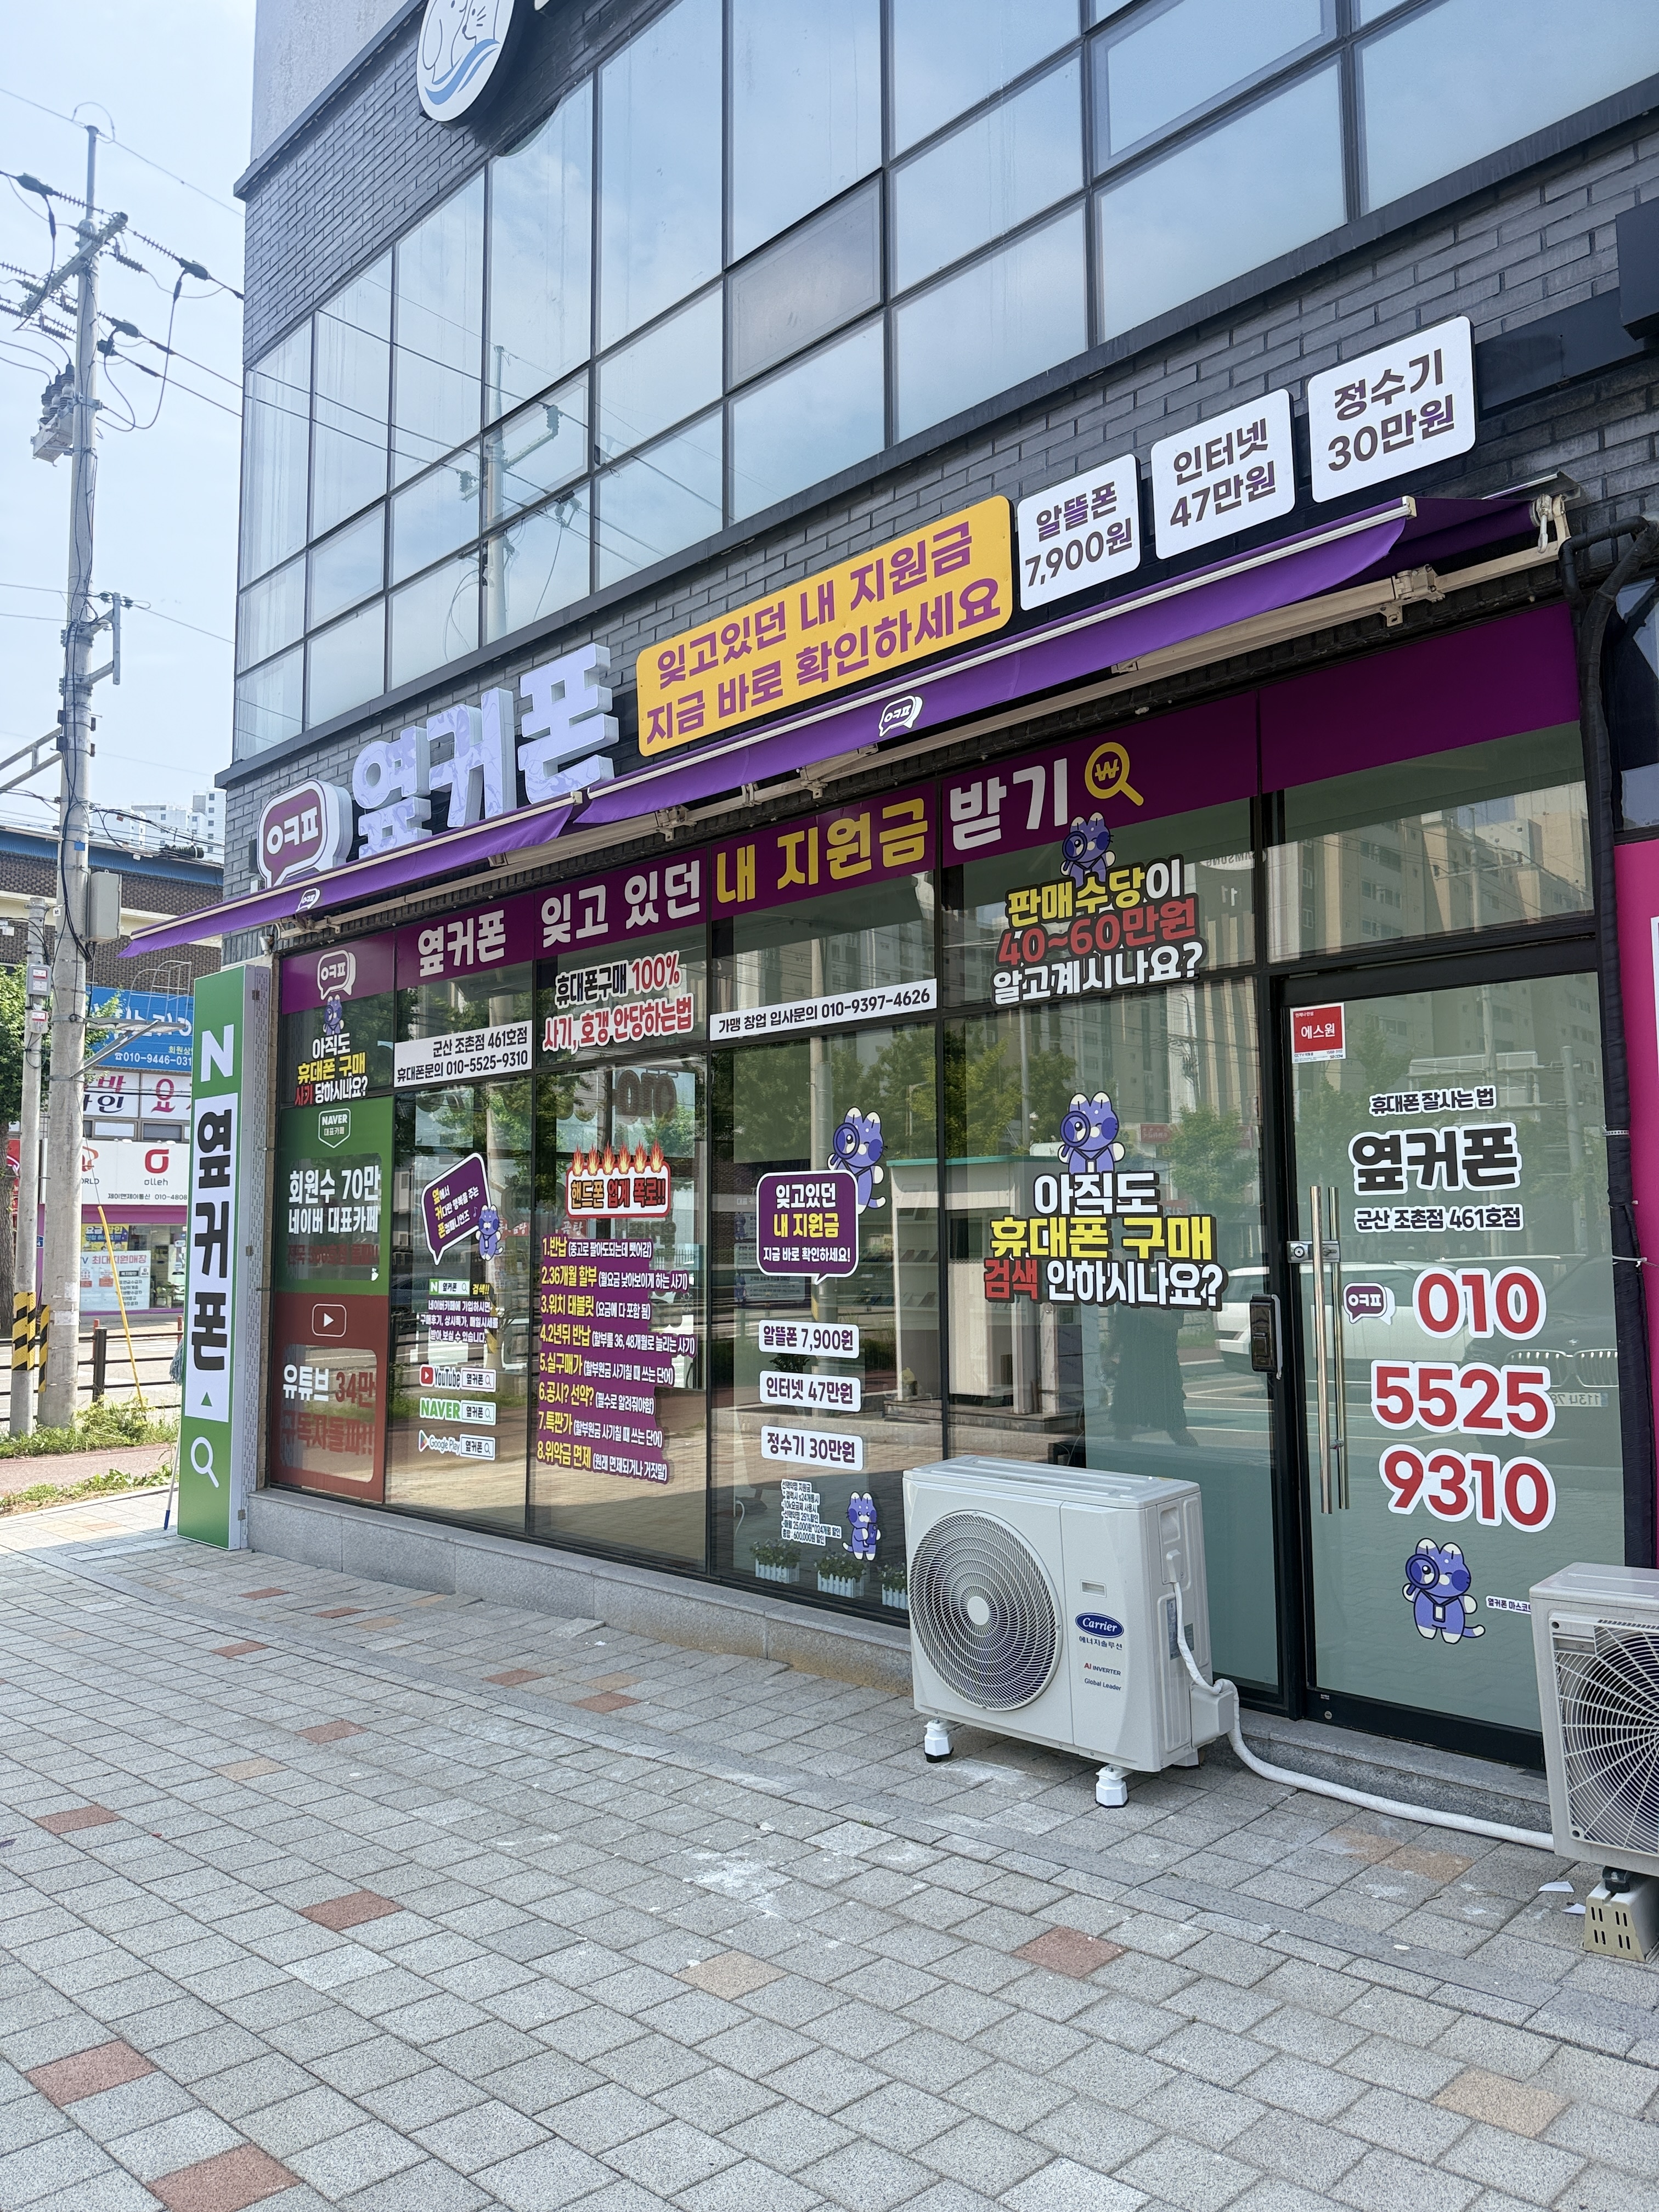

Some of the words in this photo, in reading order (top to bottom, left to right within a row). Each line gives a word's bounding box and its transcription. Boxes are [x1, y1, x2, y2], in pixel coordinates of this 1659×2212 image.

[1334, 348, 1443, 421] 정수기
[1328, 394, 1455, 472] 30만원
[1173, 417, 1268, 487] 인터넷
[1170, 460, 1276, 528] 47만원
[1036, 482, 1117, 542] 알뜰폰
[1025, 518, 1133, 589] 7,900원
[658, 601, 786, 690] 잊고있던
[800, 580, 834, 631] 내
[850, 521, 972, 611] 지원금
[646, 690, 706, 745] 지금
[718, 661, 783, 719] 바로
[796, 577, 1001, 686] 확인하세요
[352, 643, 619, 859] 옆커폰
[418, 909, 506, 978] 옆커폰
[541, 884, 608, 948] 잊고
[623, 860, 700, 930] 있던
[716, 845, 755, 904] 내
[777, 798, 928, 890] 지원금
[950, 758, 1068, 851] 받기
[1008, 859, 1180, 927] 판매수당이
[998, 897, 1195, 966] 40~60만원
[557, 963, 627, 1006] 휴대폰구매
[632, 952, 679, 992] 100%
[993, 942, 1203, 1006] 알고계시나요?
[545, 1015, 578, 1051] 사기,
[581, 1010, 609, 1043] 호갱
[614, 996, 691, 1039] 안당하는법
[719, 1016, 741, 1034] 가맹
[744, 1013, 766, 1030] 창업
[770, 1005, 818, 1027] 입사문의
[821, 988, 930, 1019] 010-9397-4626
[312, 1033, 351, 1059] 아직도
[433, 1039, 452, 1058] 군산
[455, 1034, 484, 1054] 조촌점
[487, 1026, 527, 1049] 461호점
[1301, 1023, 1335, 1039] 에스원
[123, 1052, 191, 1066] 010-9446-031
[201, 1024, 234, 1082] N
[297, 1060, 335, 1085] 휴대폰
[338, 1052, 366, 1077] 구매
[397, 1063, 443, 1083] 휴대폰문의
[446, 1050, 527, 1076] 010-5525-9310
[294, 1084, 313, 1105] 사기
[315, 1076, 368, 1104] 당하시나요?
[1372, 1093, 1419, 1115] 휴대폰
[1422, 1091, 1473, 1110] 잘사는
[1477, 1087, 1493, 1107] 법
[321, 1114, 348, 1125] NAVER
[1352, 1127, 1517, 1191] 옆커폰
[289, 1170, 335, 1204] 회원수
[341, 1165, 381, 1201] 70만
[432, 1184, 450, 1205] 옆에서
[571, 1178, 603, 1209] 핸드폰
[607, 1178, 630, 1208] 업계
[634, 1178, 665, 1206] 폭로!!
[776, 1182, 836, 1209] 잊고있던
[1034, 1173, 1158, 1215] 아직도
[288, 1206, 324, 1235] 네이버
[328, 1204, 379, 1233] 대표카페
[435, 1201, 453, 1221] 커다란
[452, 1192, 469, 1210] 행복을
[467, 1186, 479, 1200] 주는
[1357, 1210, 1389, 1230] 군산
[1394, 1209, 1443, 1229] 조촌점
[1449, 1207, 1520, 1228] 461호점
[191, 1108, 232, 1372] 옆커폰
[774, 1212, 788, 1239] 내
[792, 1212, 839, 1239] 지원금
[991, 1217, 1108, 1258] 휴대폰
[1122, 1217, 1211, 1260] 구매
[543, 1238, 567, 1257] 1.반납
[568, 1242, 589, 1257] (중고로
[590, 1242, 628, 1257] 팔아도되는데
[763, 1247, 780, 1262] 지금
[782, 1247, 800, 1262] 바로
[802, 1247, 851, 1263] 확인하세요!
[431, 1282, 438, 1292] N
[472, 1284, 490, 1295] 검색!!
[541, 1265, 577, 1286] 2.36개월
[579, 1265, 597, 1288] 할부
[599, 1271, 620, 1288] (월요금
[622, 1272, 654, 1289] 낮아보이게
[656, 1272, 669, 1289] 하는
[671, 1273, 688, 1290] 사기)
[985, 1260, 1037, 1300] 검색
[1047, 1261, 1223, 1306] 안하시나요?
[541, 1295, 565, 1316] 3.워치
[568, 1295, 594, 1317] 태블릿
[596, 1301, 617, 1318] (요금에
[618, 1303, 625, 1318] 다
[627, 1303, 640, 1319] 포함
[1418, 1273, 1539, 1334] 010
[540, 1325, 571, 1345] 4.2년뒤
[573, 1325, 591, 1347] 반납
[592, 1330, 613, 1349] (할부를
[614, 1334, 624, 1350] 36,
[626, 1334, 654, 1352] 48개월로
[656, 1334, 676, 1353] 늘리는
[678, 1337, 695, 1355] 사기)
[763, 1325, 797, 1347] 알뜰폰
[800, 1328, 853, 1352] 7,900원
[435, 1368, 460, 1387] YouTube
[540, 1353, 582, 1375] 5.실구매가
[584, 1359, 612, 1379] (할부원금
[612, 1363, 632, 1381] 사기칠
[641, 1364, 656, 1383] 쓰는
[657, 1365, 674, 1385] 단어)
[283, 1364, 329, 1402] 유튜브
[335, 1372, 376, 1408] 34만
[539, 1382, 569, 1404] 6.공시?
[571, 1385, 594, 1407] 선약?
[595, 1391, 617, 1410] (필수로
[766, 1377, 803, 1400] 인터넷
[808, 1380, 853, 1404] 47만원
[1375, 1366, 1548, 1433] 5525
[421, 1400, 460, 1419] NAVER
[430, 1437, 448, 1451] Google
[449, 1440, 460, 1453] Play
[537, 1440, 572, 1466] 8.위약금
[574, 1444, 591, 1469] 면제
[592, 1452, 608, 1471] (원래
[610, 1453, 643, 1477] 면제되거나
[644, 1459, 668, 1481] 거짓말)
[767, 1432, 804, 1457] 정수기
[809, 1437, 855, 1464] 30만원
[1384, 1451, 1549, 1526] 9310
[1488, 1598, 1507, 1609] 옆커폰
[1082, 1617, 1117, 1632] Carrier
[1079, 1635, 1122, 1651] 에너지솔루션
[1085, 1678, 1101, 1686] Global
[1103, 1682, 1121, 1691] Leader
[1093, 1665, 1121, 1676] INVERTER
